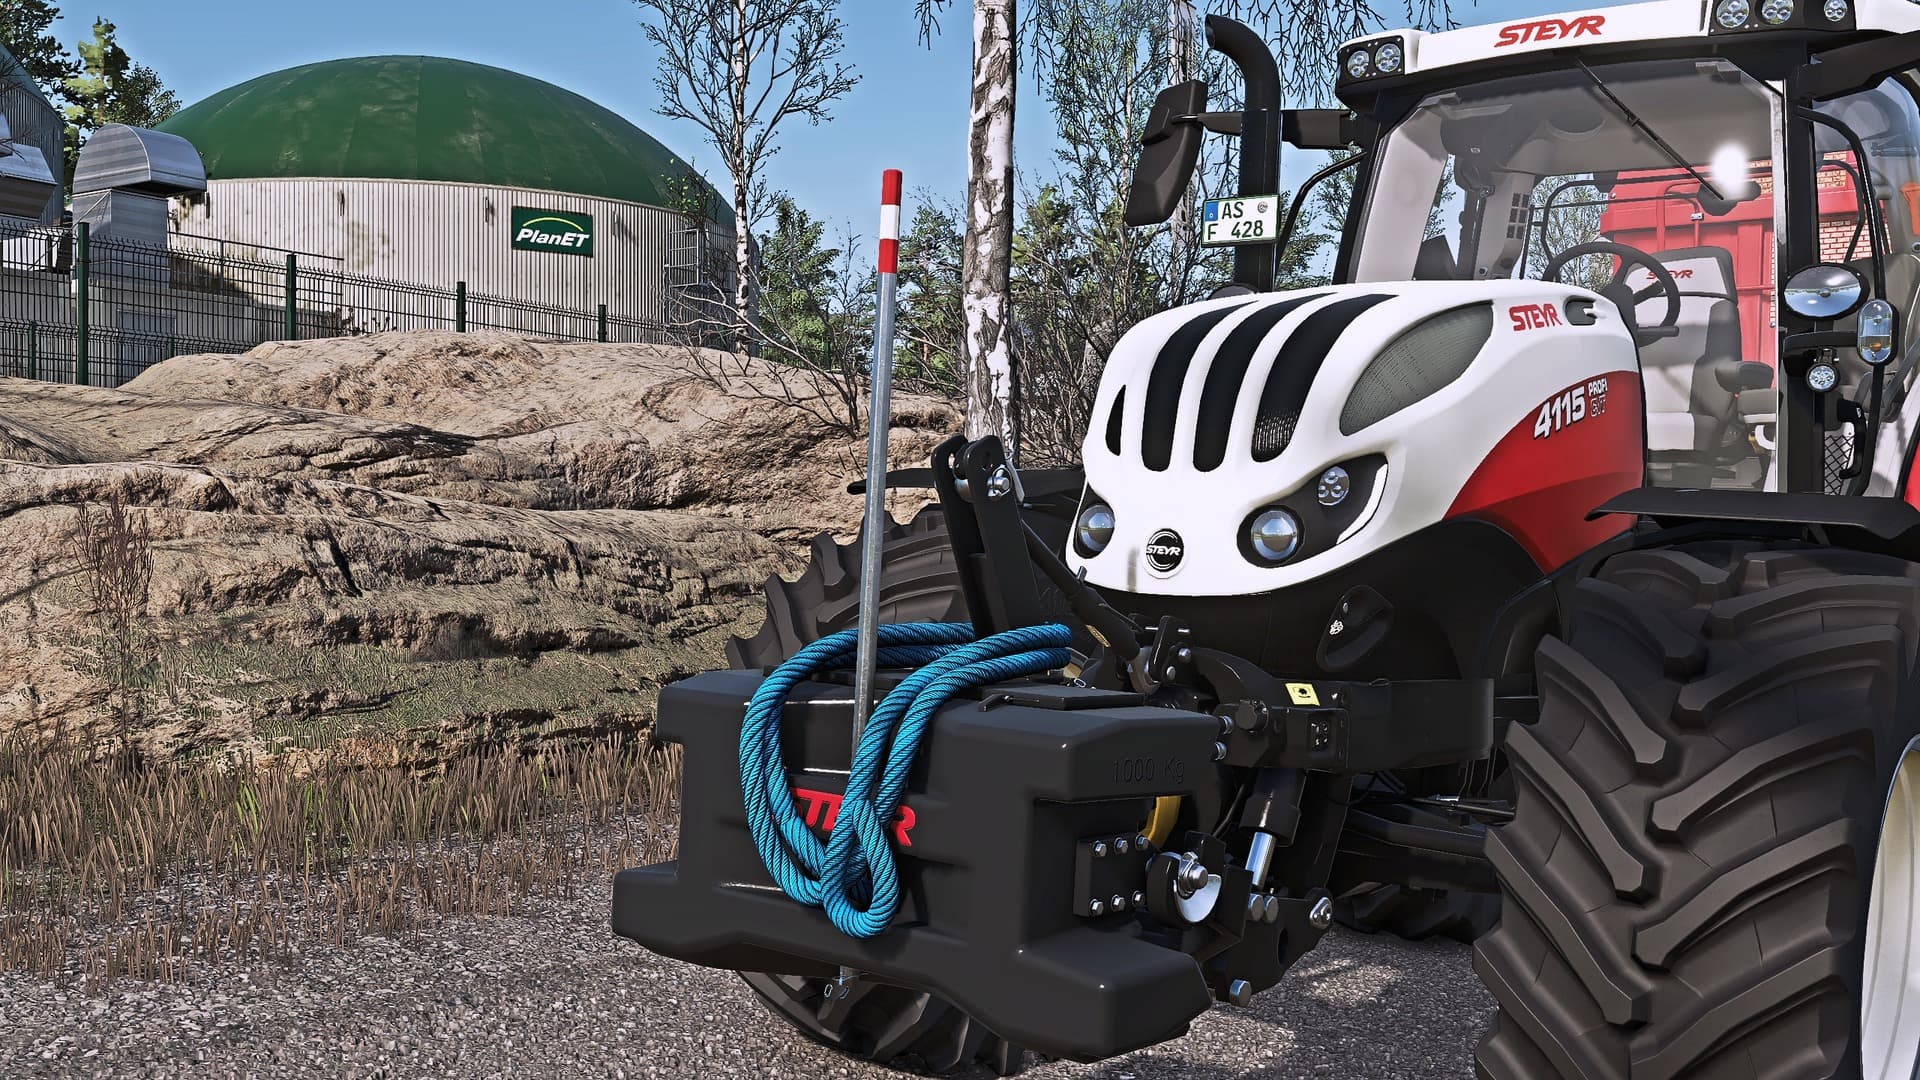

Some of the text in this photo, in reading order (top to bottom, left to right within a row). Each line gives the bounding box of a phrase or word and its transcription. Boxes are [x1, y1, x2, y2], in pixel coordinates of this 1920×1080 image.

[1494, 15, 1606, 48] STEYR
[1221, 201, 1244, 220] AS
[515, 228, 590, 248] PlanET
[1207, 220, 1264, 240] F 428
[1508, 303, 1563, 332] STEYR
[1533, 377, 1608, 439] 4115 PROFI
[1146, 544, 1181, 556] STEYR
[1113, 758, 1155, 782] 1000
